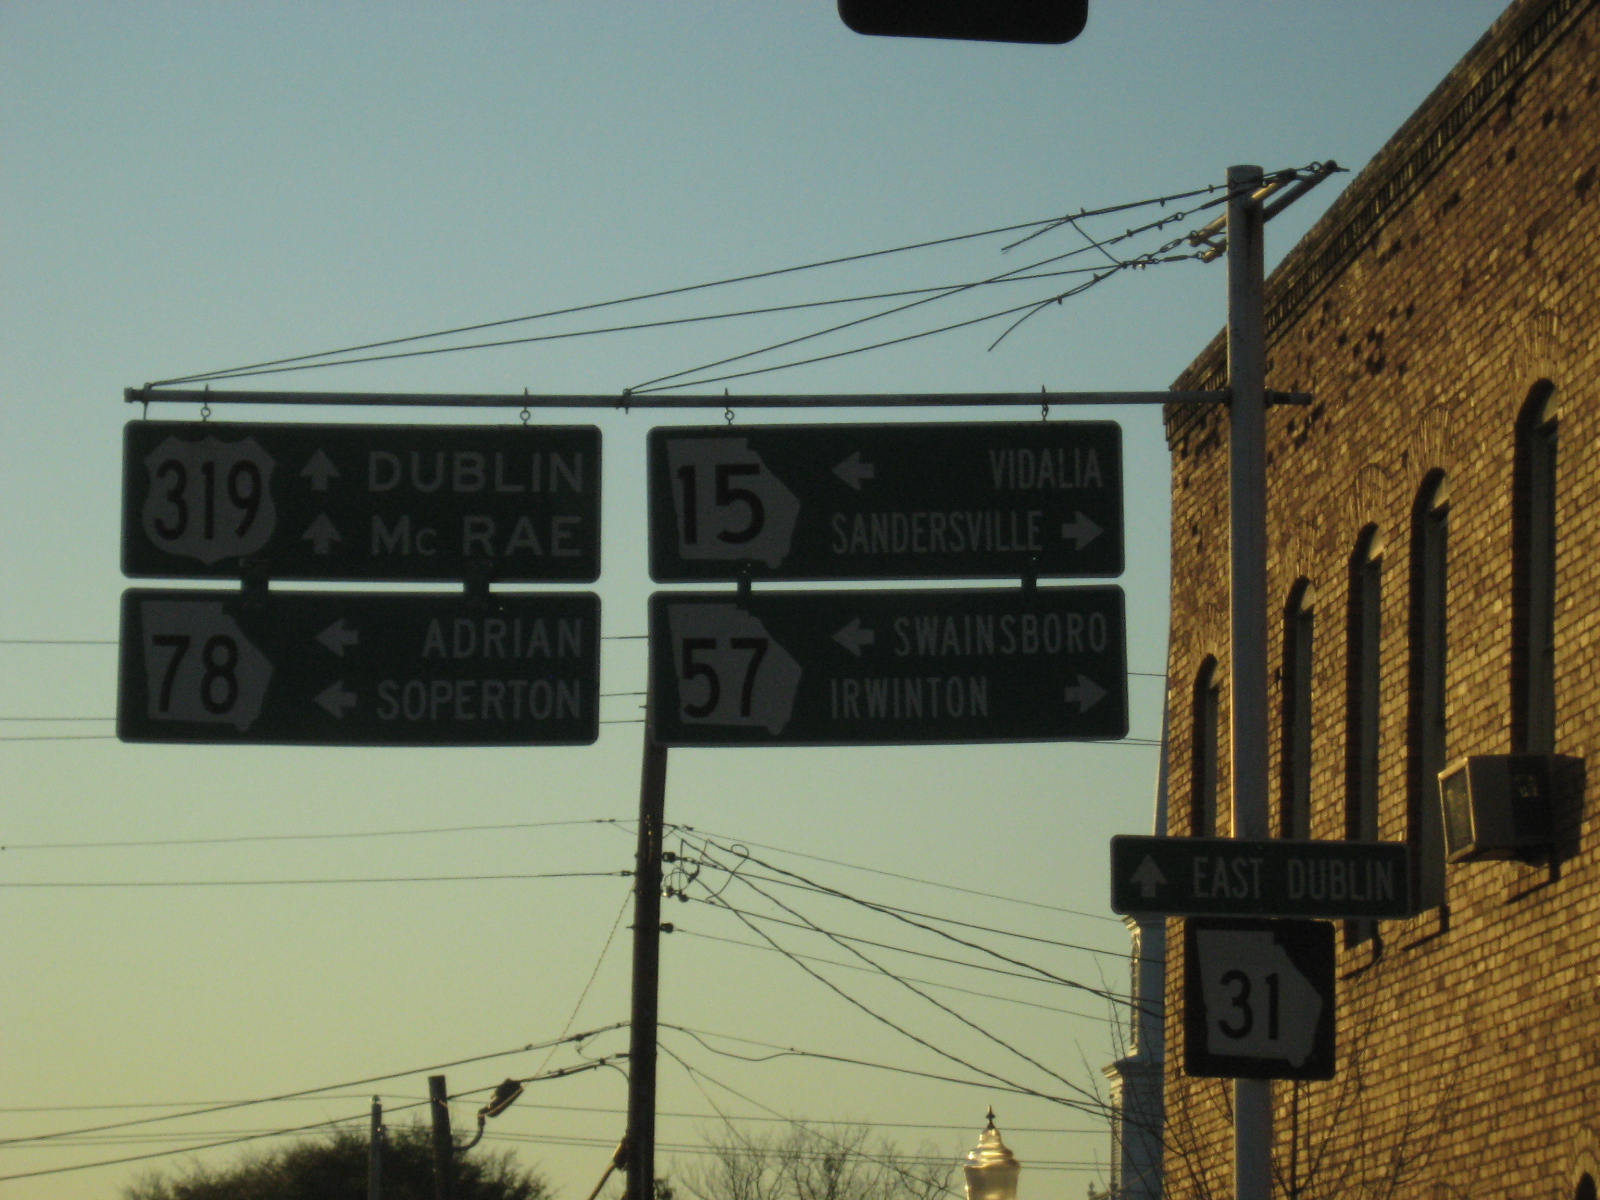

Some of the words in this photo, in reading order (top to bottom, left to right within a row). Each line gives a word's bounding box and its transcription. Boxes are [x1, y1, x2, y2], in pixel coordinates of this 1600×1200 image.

[368, 451, 583, 493] DUBLIN
[988, 449, 1103, 489] VIDALIA
[154, 460, 261, 540] 319
[677, 464, 764, 544] 15
[371, 515, 438, 556] Mc
[462, 515, 582, 557] RAE
[832, 510, 1043, 554] SANDERSVILLE
[422, 618, 581, 658] ADRIAN
[894, 612, 1107, 656] SWAINSBORO
[152, 634, 238, 715] 78
[682, 638, 769, 718] 57
[376, 679, 581, 720] SOPERTON
[831, 676, 988, 719] IRWINTON
[1193, 857, 1264, 899] EAST
[1288, 859, 1393, 900] DUBLIN
[1218, 970, 1278, 1040] 31
